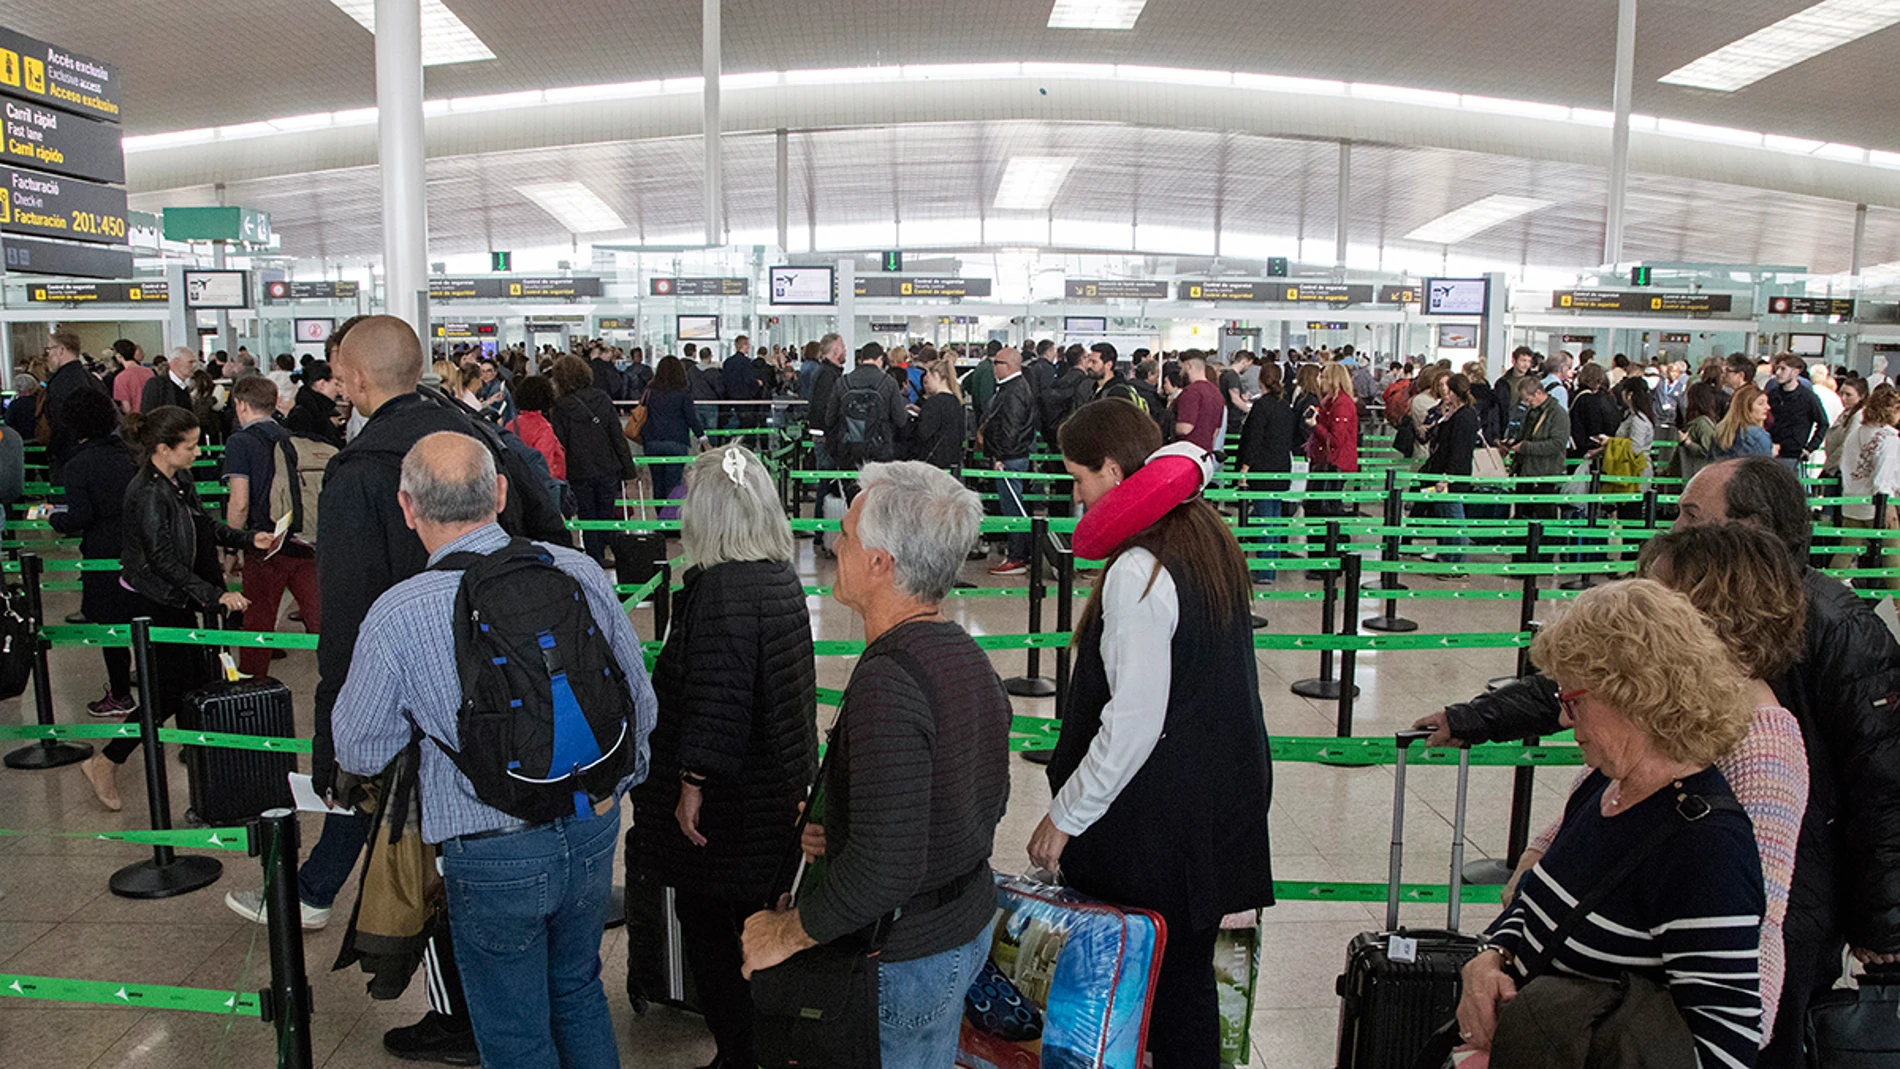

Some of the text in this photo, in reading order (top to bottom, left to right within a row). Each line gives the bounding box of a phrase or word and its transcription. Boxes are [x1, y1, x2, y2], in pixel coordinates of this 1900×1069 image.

[47, 65, 102, 94] Exclusive access
[75, 60, 109, 81] exclusiu
[49, 82, 119, 114] Acceso exclusivo
[6, 102, 32, 122] Carril
[7, 121, 43, 141] Fast lane
[8, 138, 34, 157] Carril
[12, 172, 59, 195] Facturació
[13, 192, 43, 208] Check-in
[14, 208, 67, 229] Facturación
